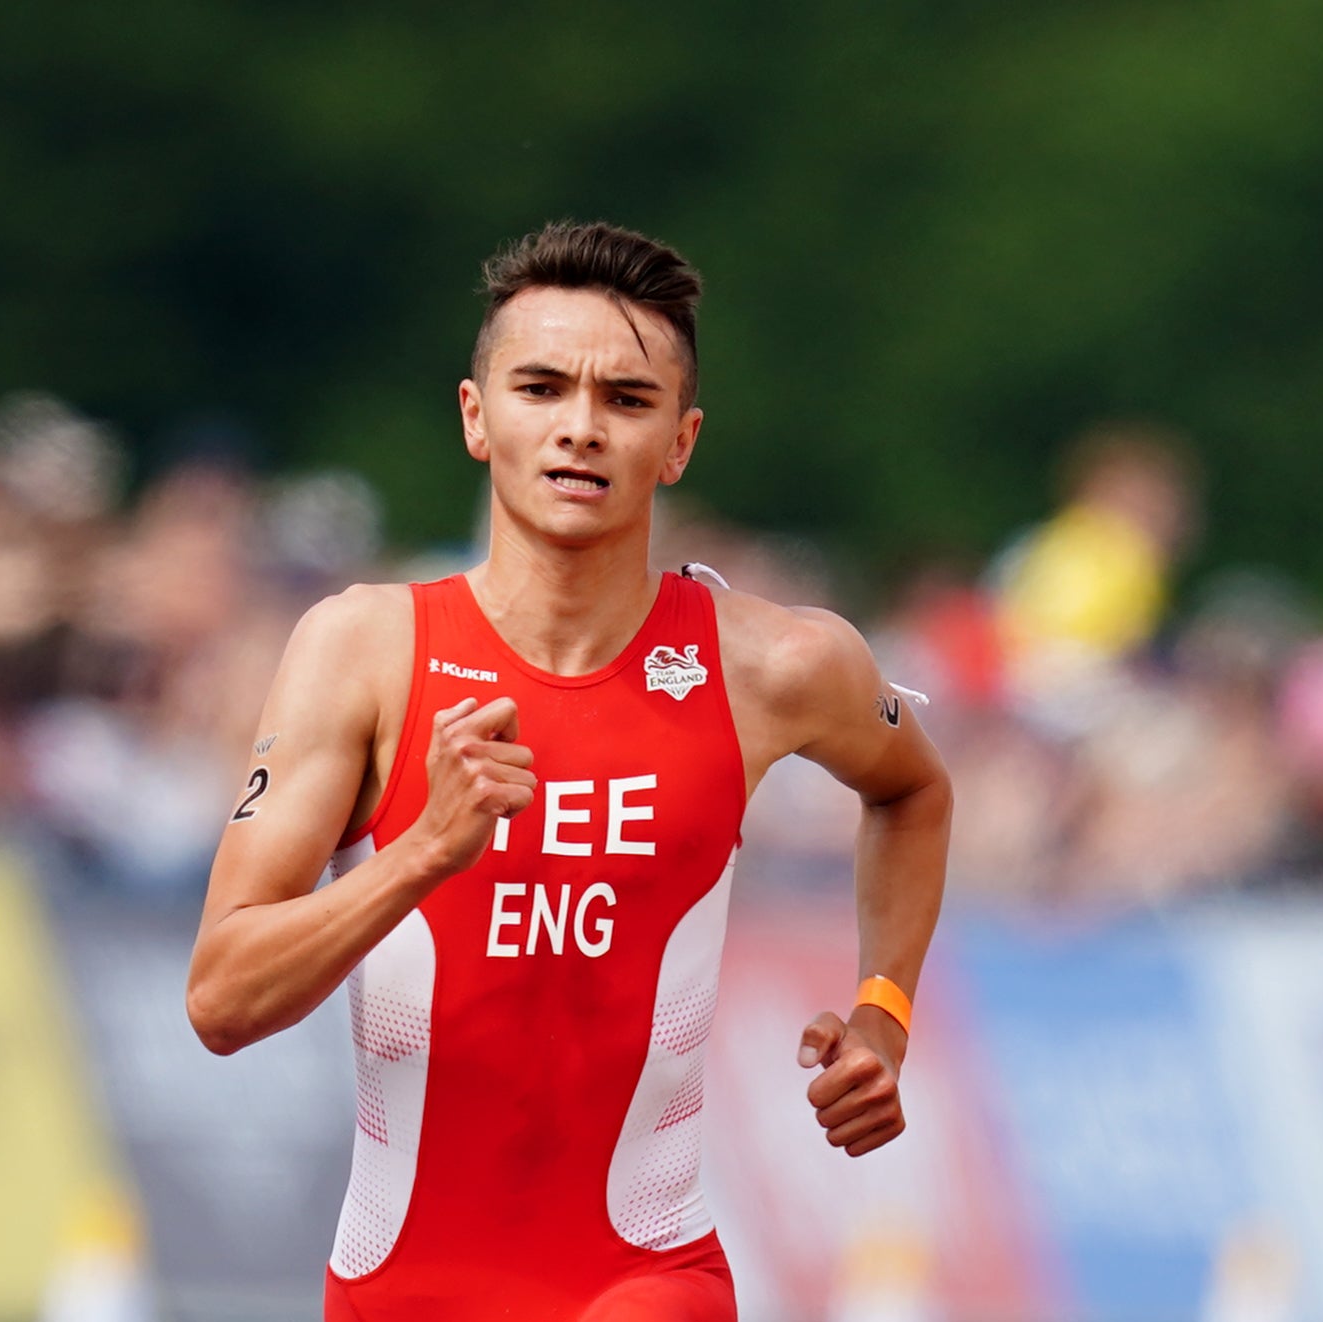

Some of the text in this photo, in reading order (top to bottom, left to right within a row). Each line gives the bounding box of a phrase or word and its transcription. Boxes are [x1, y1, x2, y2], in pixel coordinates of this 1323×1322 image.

[441, 661, 498, 683] KUKRI
[650, 673, 703, 687] ENGLAND
[232, 767, 269, 821] 2
[486, 881, 617, 958] ENG
